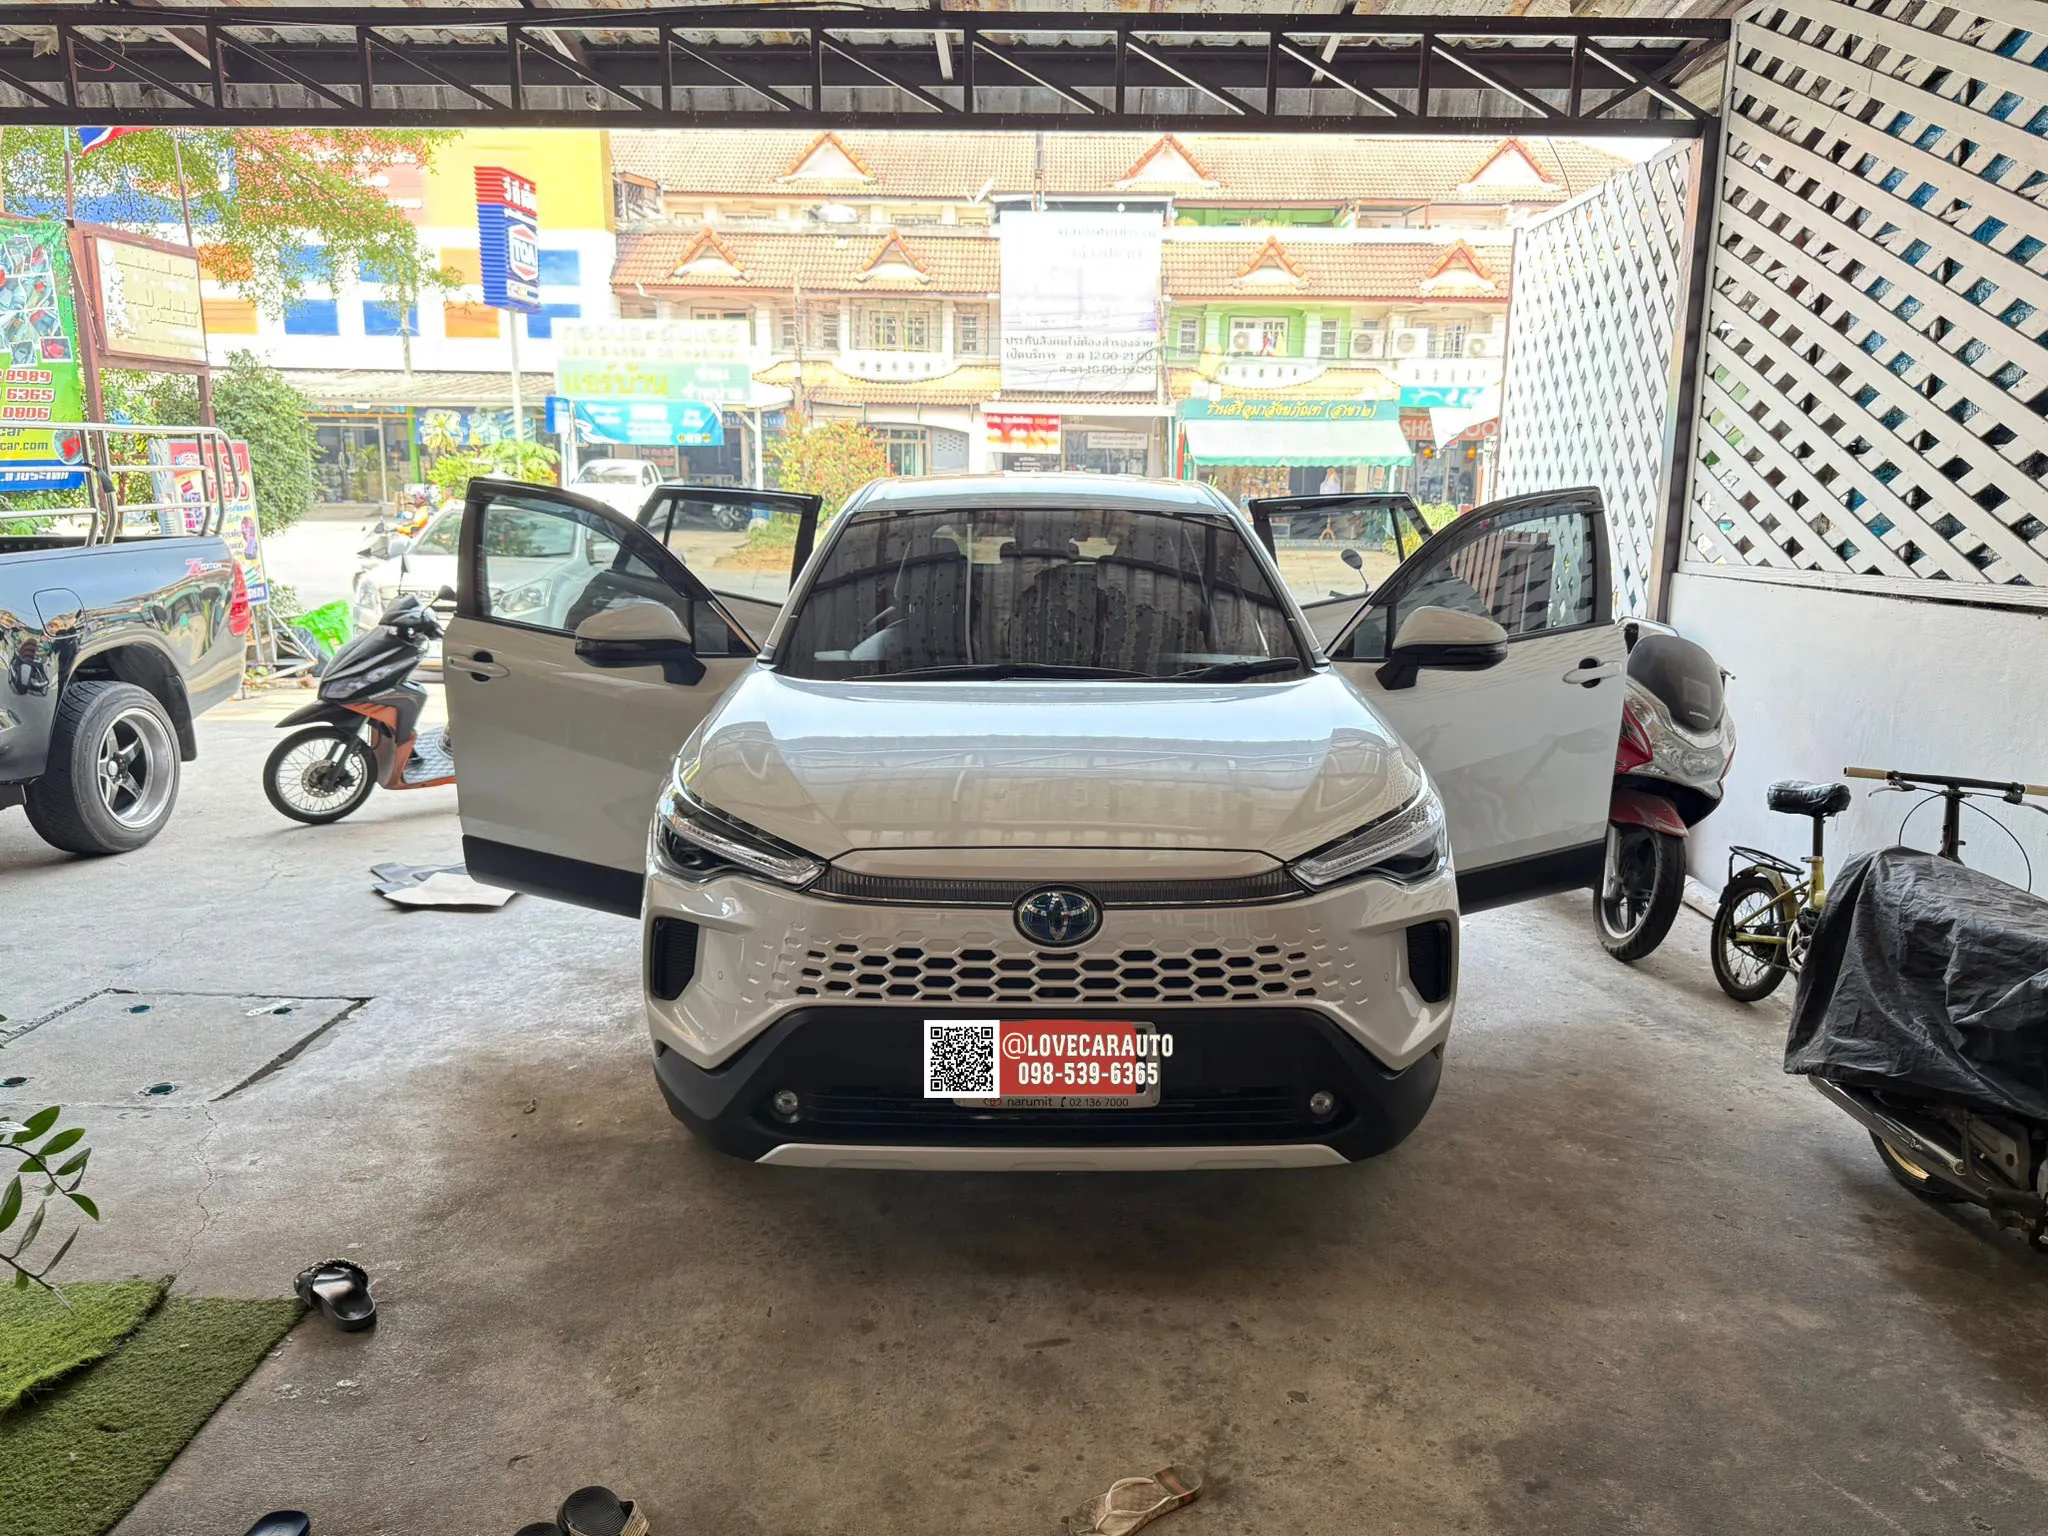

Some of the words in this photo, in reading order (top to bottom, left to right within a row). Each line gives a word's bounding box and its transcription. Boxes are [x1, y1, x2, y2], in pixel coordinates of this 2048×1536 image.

[5, 369, 51, 383] 8989
[562, 361, 669, 397] แอร์บ้าน
[7, 388, 53, 401] 6365
[2, 406, 49, 419] 0806
[1007, 1097, 1053, 1108] narumit
[1069, 1098, 1082, 1108] 02
[1085, 1098, 1102, 1108] 136
[1104, 1098, 1129, 1108] 7000
